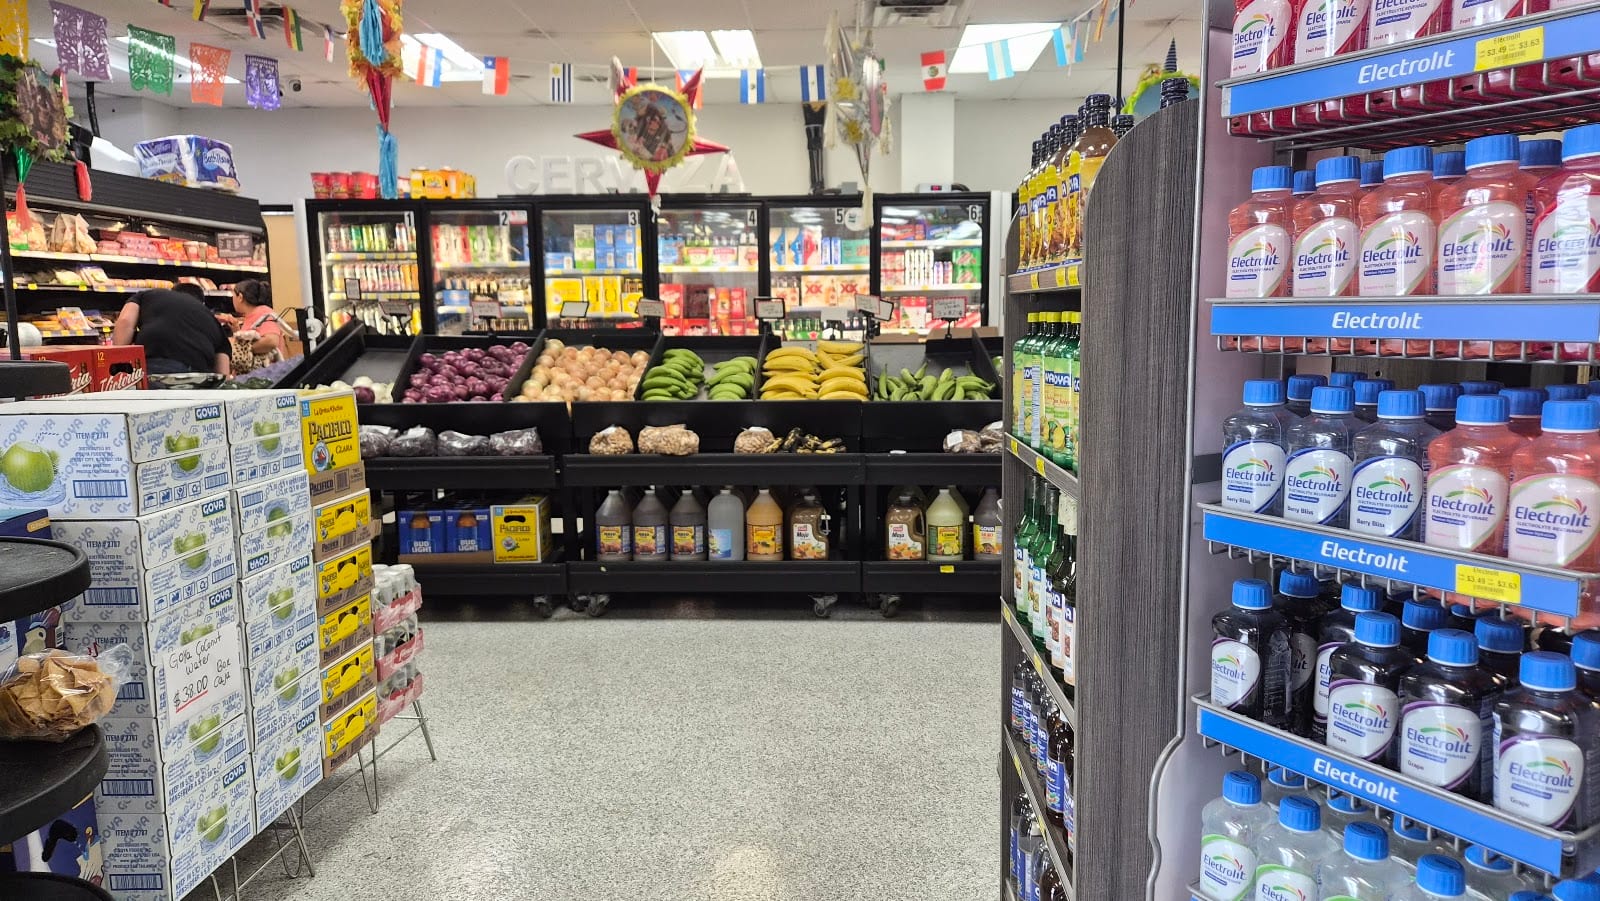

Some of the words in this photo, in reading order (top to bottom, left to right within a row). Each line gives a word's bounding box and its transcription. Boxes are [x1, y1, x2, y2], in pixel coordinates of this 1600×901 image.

[1305, 4, 1358, 26] Elecolit
[1487, 46, 1507, 57] $3.49
[1358, 50, 1456, 85] Electrolit
[504, 154, 746, 195] CERVZA
[406, 212, 413, 227] 1
[501, 211, 509, 226] 2
[629, 211, 638, 226] 3
[748, 210, 756, 225] 4
[836, 208, 843, 223] 5
[970, 206, 978, 220] 6
[1443, 238, 1514, 257] Electolit
[1231, 254, 1279, 268] Electrolit
[1298, 249, 1349, 267] Electrolit
[1331, 311, 1423, 330] Electrolit
[96, 351, 105, 361] 12
[100, 367, 144, 392] Victoria
[1045, 371, 1055, 384] YA
[1053, 374, 1070, 387] OYA
[277, 395, 296, 406] GOYA
[195, 406, 219, 419] GOYA
[75, 432, 90, 440] ITEM
[308, 420, 352, 445] PACIFICO
[335, 445, 353, 455] CLARA
[1226, 467, 1275, 482] Electrolit
[1287, 475, 1342, 492] Electrolit
[1356, 486, 1413, 503] Electrolit
[203, 499, 226, 515] GOYA
[1431, 495, 1496, 516] Electrolit
[1356, 518, 1371, 527] Berry
[1371, 520, 1385, 528] Bliss
[1515, 505, 1592, 528] Electrolit
[86, 540, 101, 548] ITEM
[458, 544, 479, 552] LIGHT
[291, 556, 309, 571] GOYA
[1320, 540, 1409, 573] Electrolit
[210, 589, 232, 606] GOYA
[95, 636, 109, 644] ITEM
[295, 635, 314, 652] GOYA
[216, 657, 232, 673] Box
[173, 675, 209, 708] $38.00
[213, 671, 231, 688] Caja
[1011, 687, 1025, 699] OYA
[297, 712, 315, 731] GOYA
[1332, 702, 1391, 729] Electrolit
[1038, 728, 1047, 740] YA
[1407, 727, 1473, 754] Electrolit
[1047, 759, 1058, 772] YA
[223, 764, 245, 785] GOYA
[1313, 758, 1400, 803] Electrolit
[1509, 761, 1575, 788] Electrolit
[115, 829, 130, 837] ITEM
[1203, 854, 1248, 881] Electrolit
[1261, 883, 1288, 901] Elect
